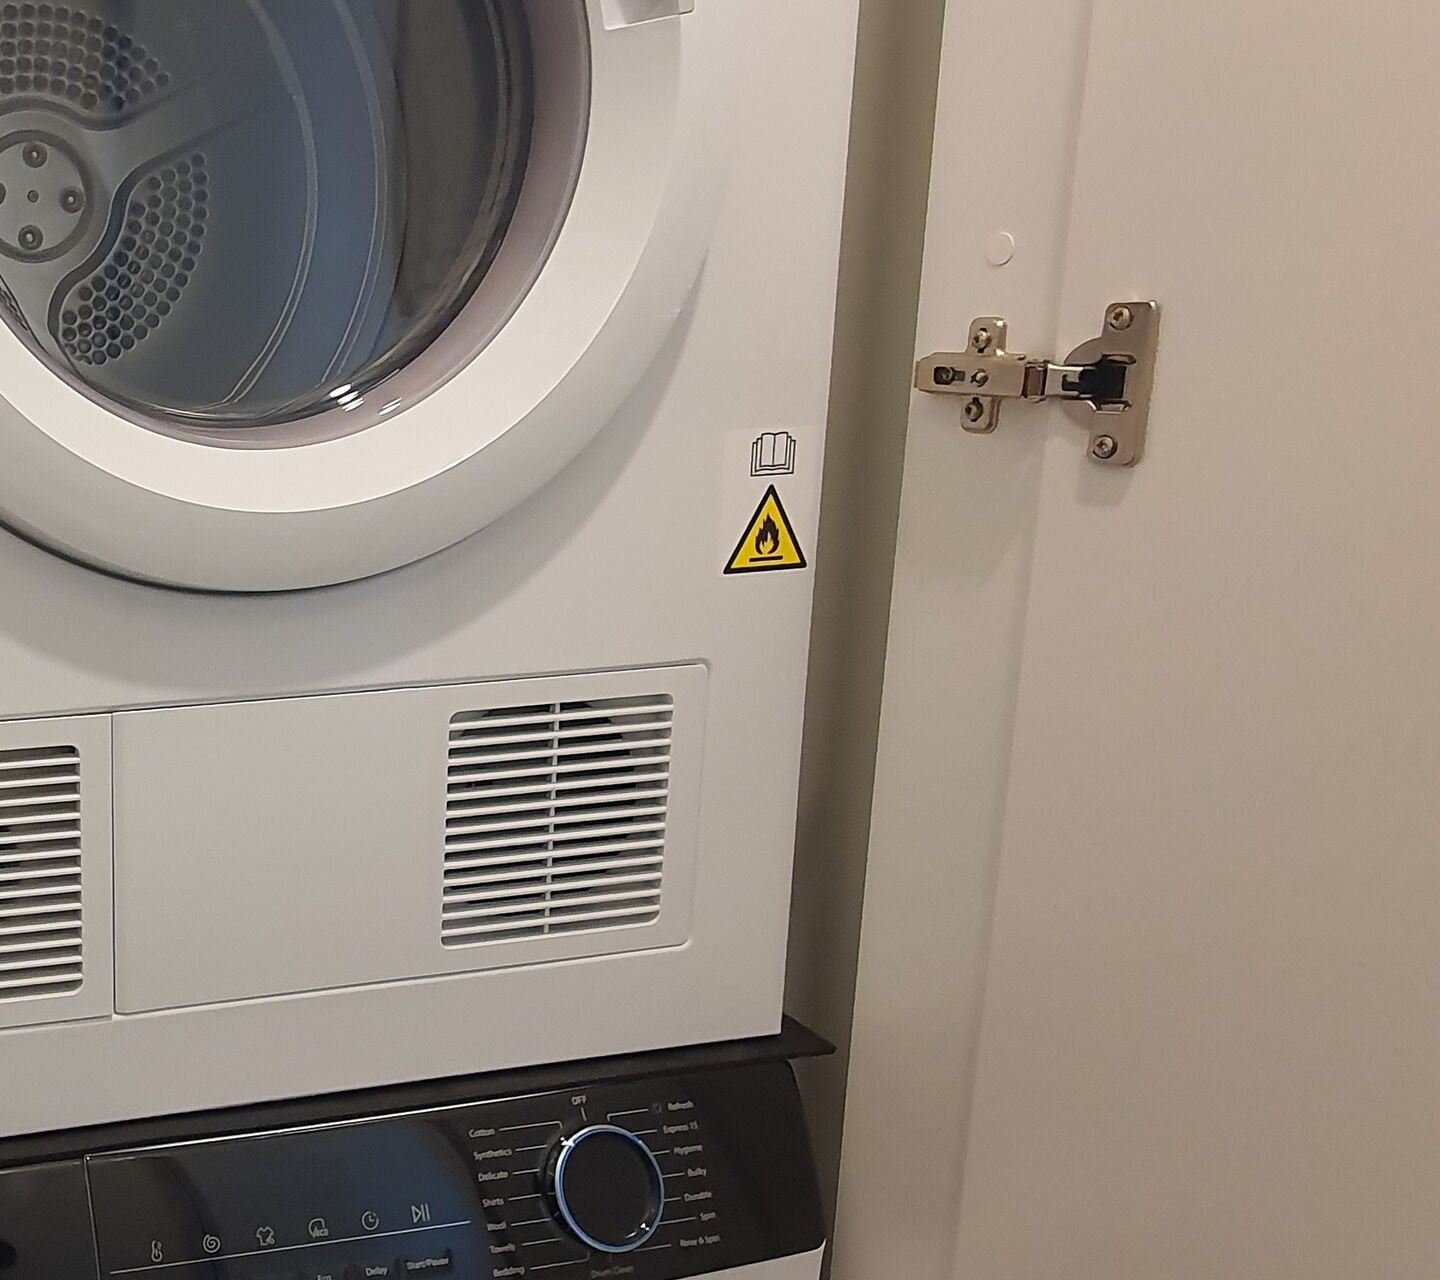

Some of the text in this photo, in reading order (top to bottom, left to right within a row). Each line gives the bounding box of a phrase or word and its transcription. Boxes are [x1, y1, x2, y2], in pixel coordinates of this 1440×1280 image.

[571, 1094, 588, 1106] OFF
[473, 1147, 513, 1161] Synthetics
[478, 1170, 509, 1182] Delicate
[482, 1197, 505, 1208] Shirts
[365, 1266, 388, 1277] Delay
